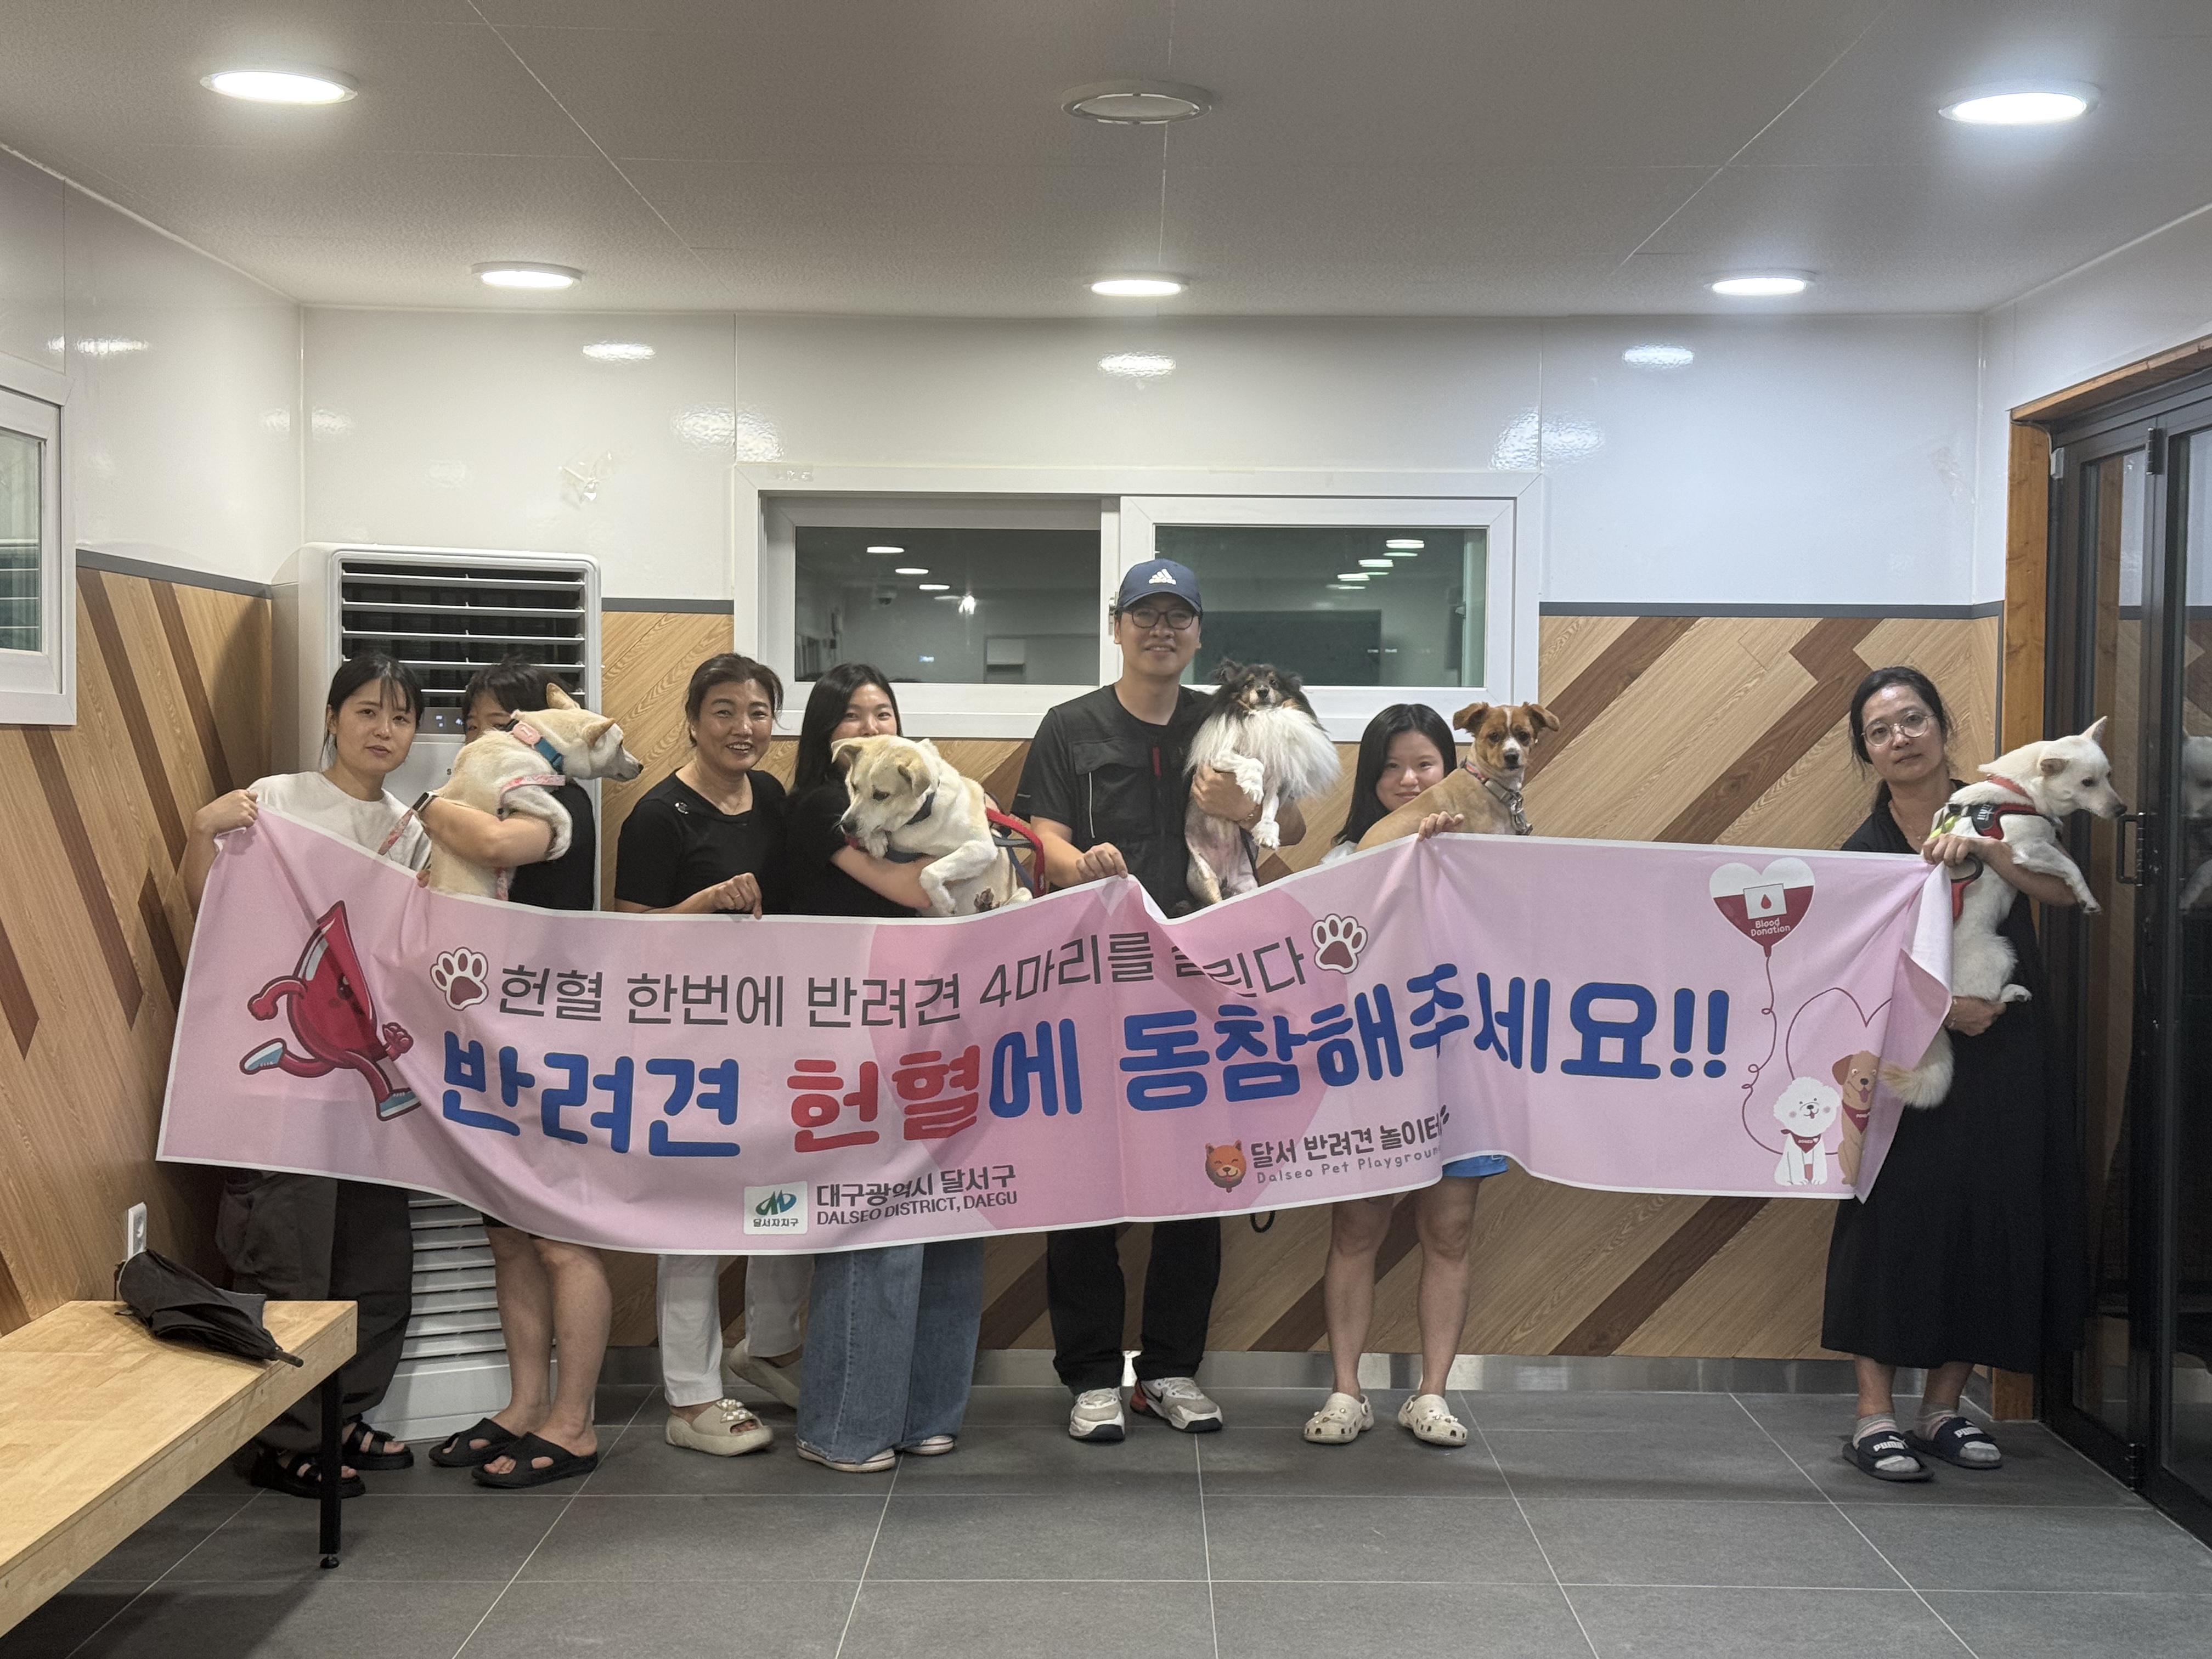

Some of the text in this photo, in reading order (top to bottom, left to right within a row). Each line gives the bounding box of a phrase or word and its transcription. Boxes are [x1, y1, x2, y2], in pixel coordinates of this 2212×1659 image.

[1751, 926, 1791, 936] Donation
[1755, 917, 1780, 928] Blood
[499, 964, 603, 1022] 헌혈
[627, 972, 784, 1028] 한번에
[808, 972, 960, 1029] 반려견
[979, 932, 1155, 1008] 4마리를
[442, 963, 1730, 1157] 반려견 헌혈에 동참해주세요!!
[1250, 1113, 1442, 1169] 달서 반려견 놀이터
[816, 1165, 1016, 1207] 대구광역시 달서구
[1257, 1170, 1313, 1183] Dalseo
[1322, 1161, 1349, 1175] Pet
[817, 1191, 1017, 1225] DALSEO DISTRICT, DAEGU
[1873, 1441, 1905, 1452] PUMA
